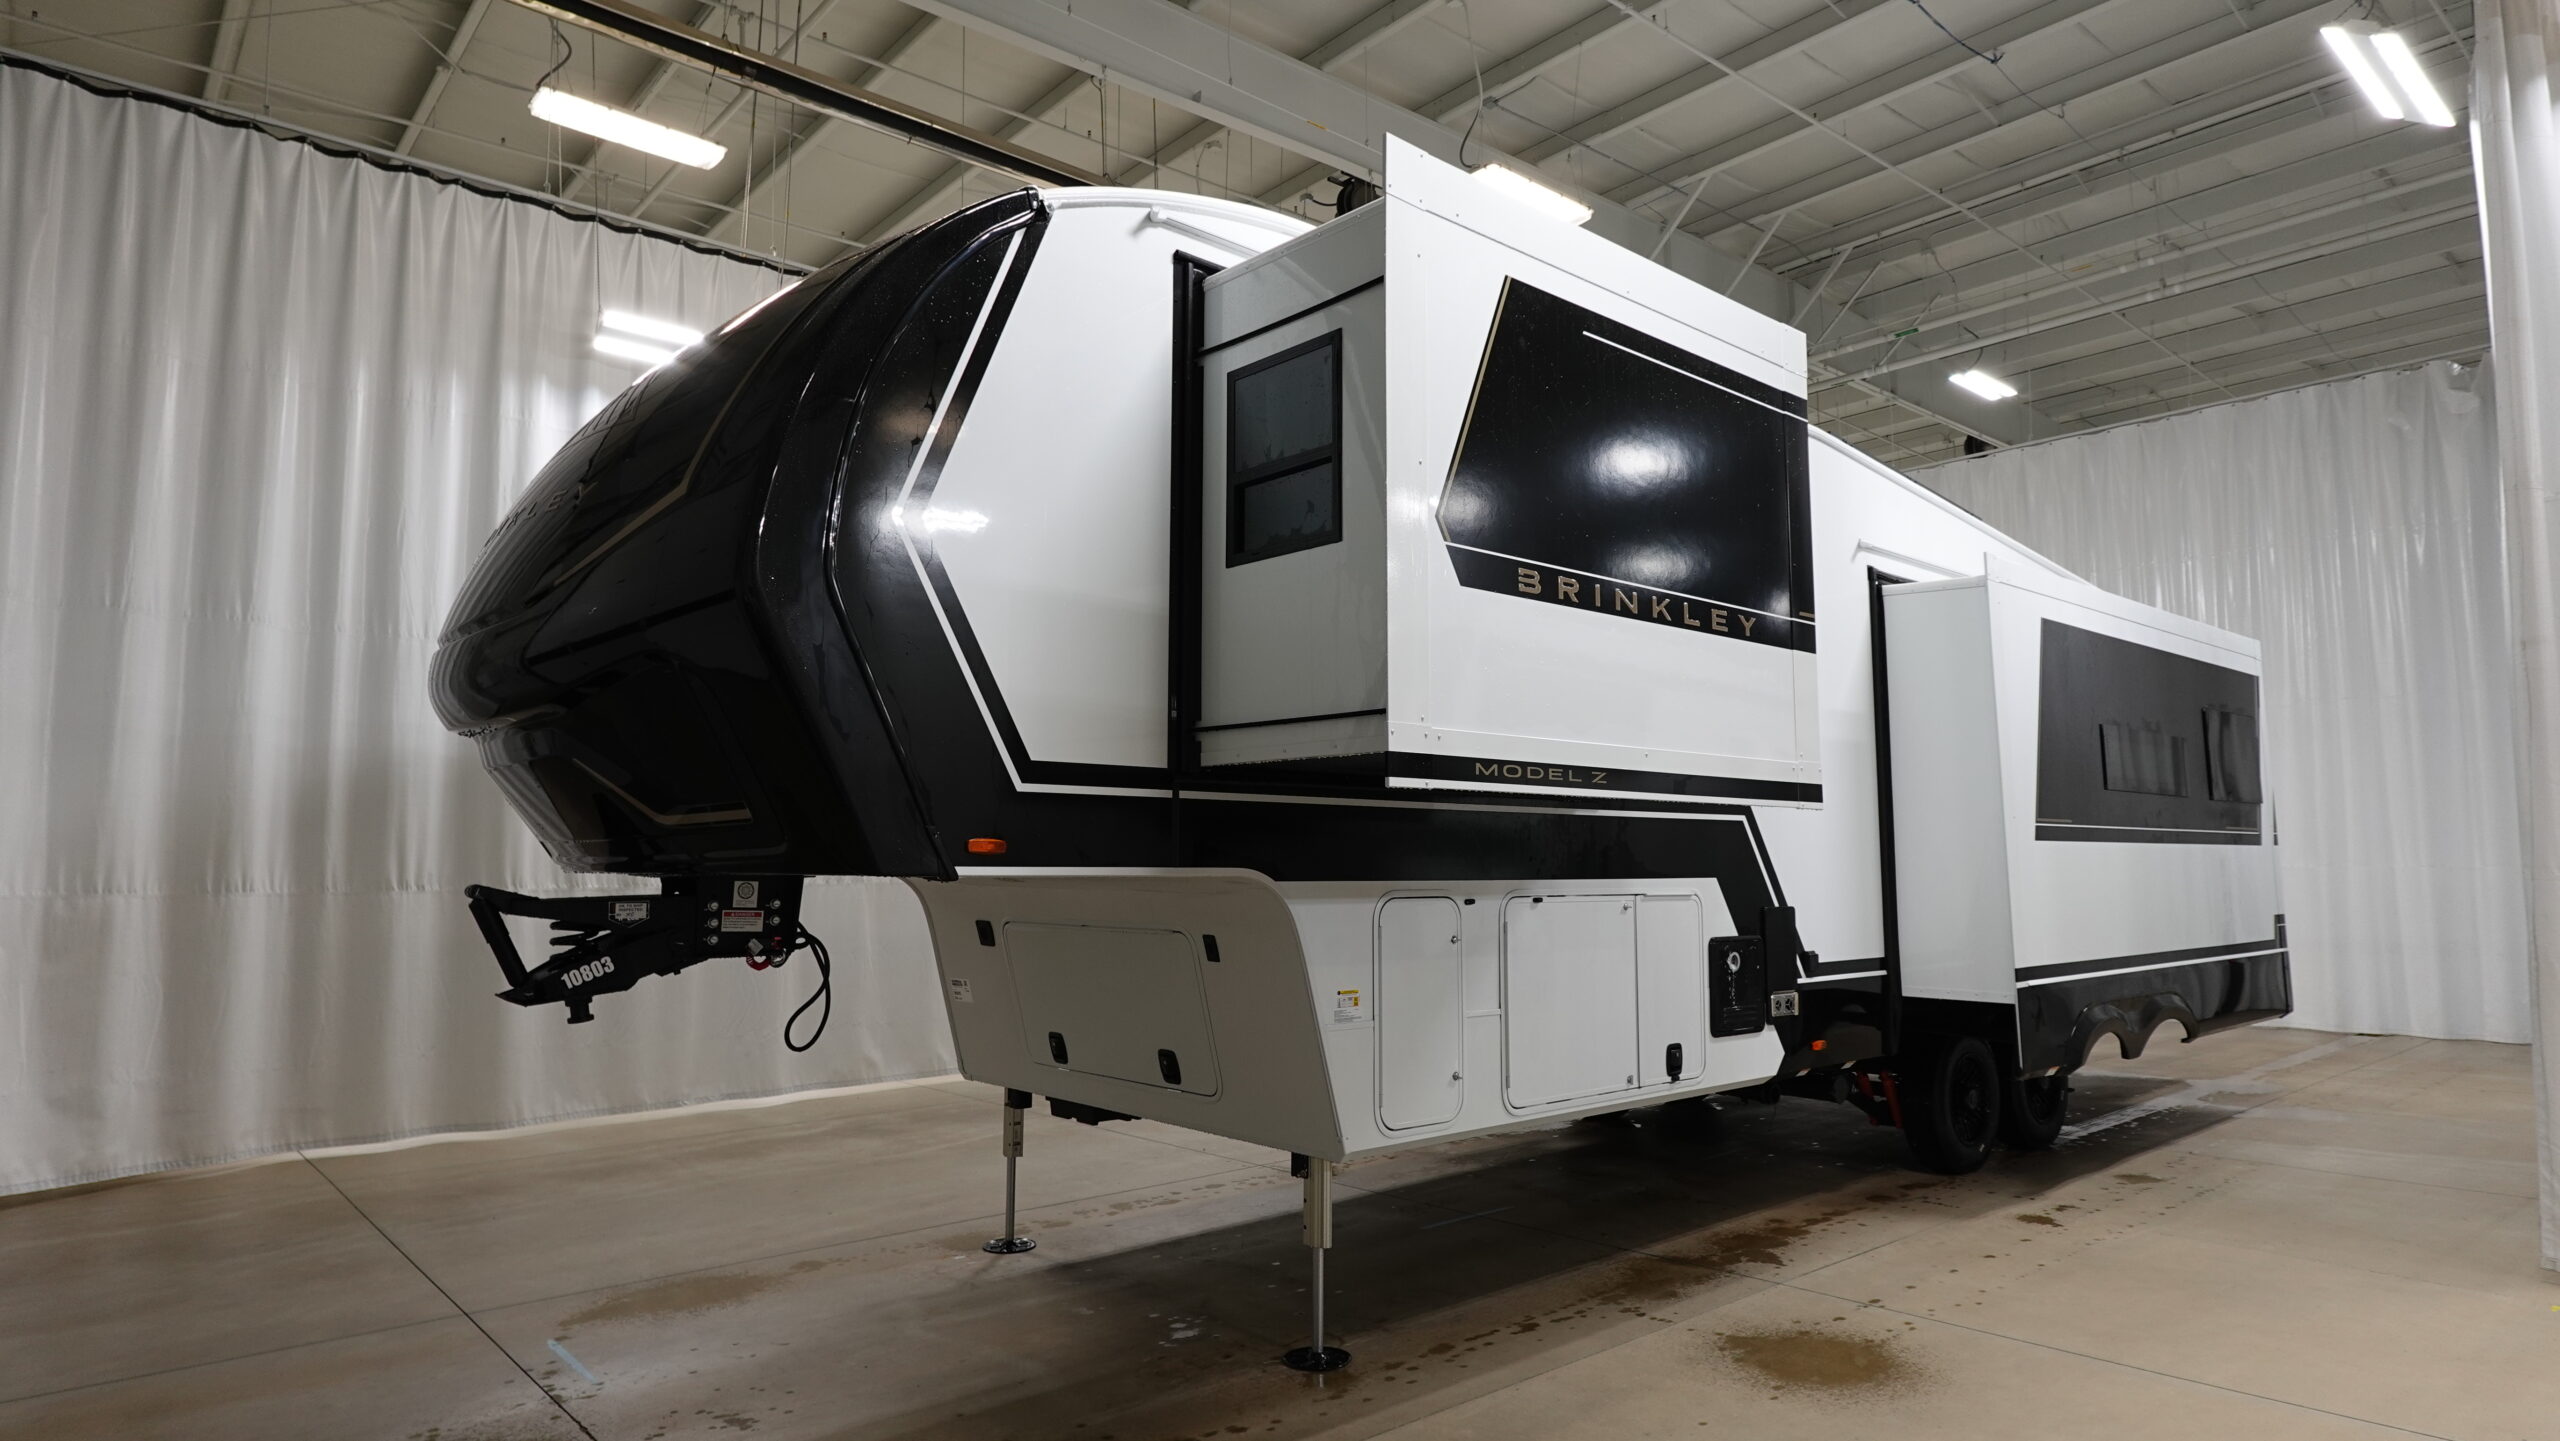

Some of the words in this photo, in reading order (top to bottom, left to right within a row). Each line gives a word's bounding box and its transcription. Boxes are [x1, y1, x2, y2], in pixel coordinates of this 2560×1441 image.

[1517, 567, 1757, 637] BRINKLEY
[1475, 762, 1583, 783] MODEL
[1591, 771, 1608, 784] Z
[560, 956, 615, 989] 10803
